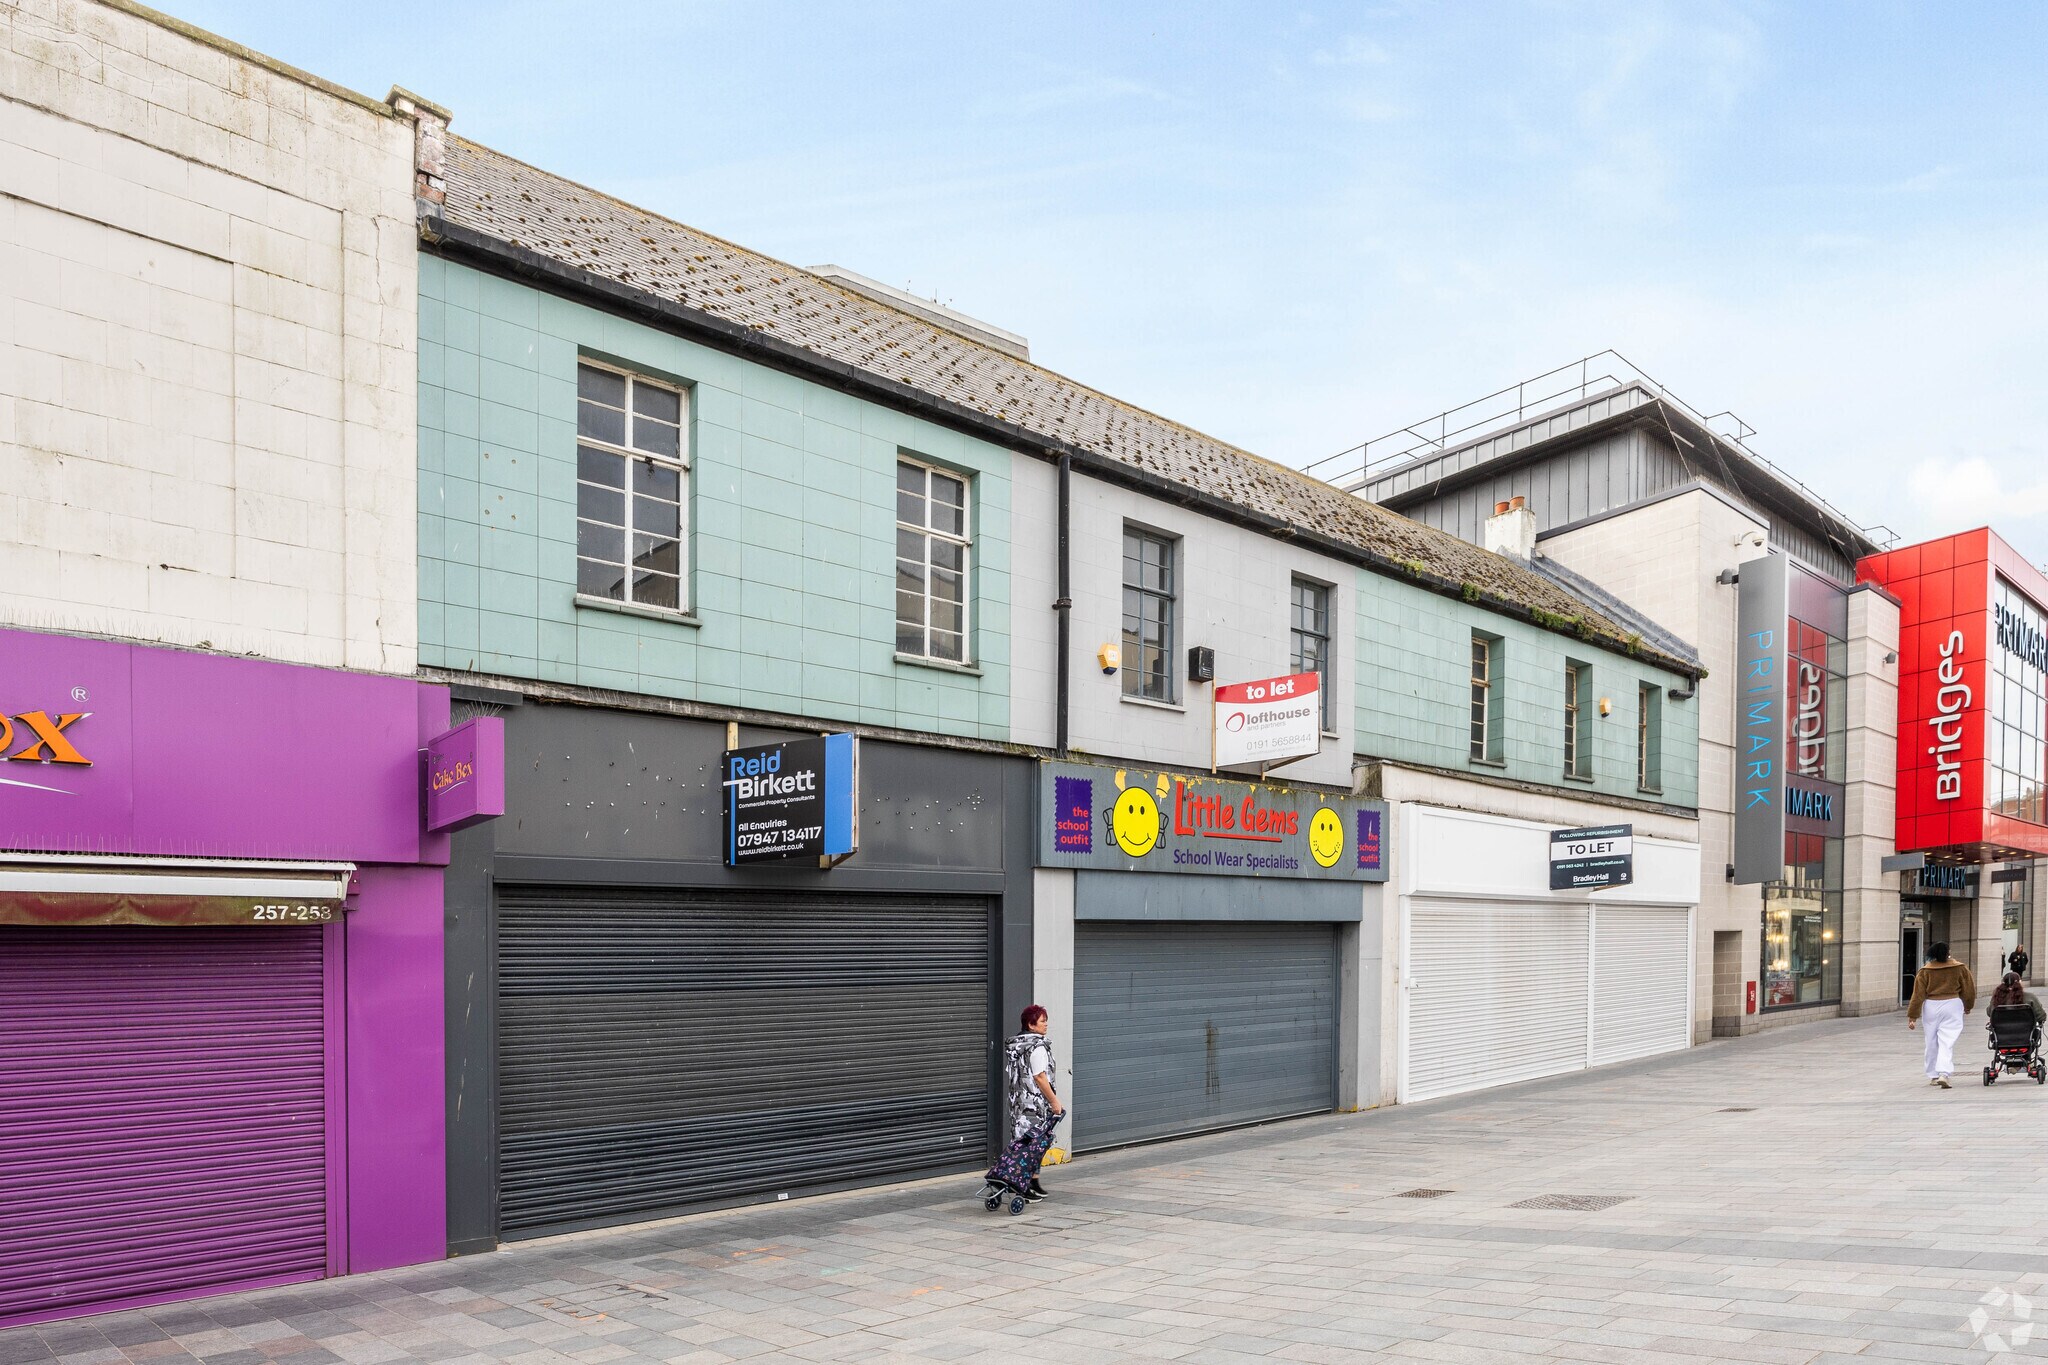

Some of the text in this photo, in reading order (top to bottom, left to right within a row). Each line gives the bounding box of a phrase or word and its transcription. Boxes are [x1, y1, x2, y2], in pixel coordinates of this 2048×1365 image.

[1994, 602, 2048, 677] PRIMAR
[1246, 679, 1295, 700] to let
[1247, 708, 1310, 725] lofthouse
[1746, 630, 1774, 810] PRIMARK
[1928, 630, 1972, 801] Bridges
[1261, 721, 1286, 731] partners
[1246, 739, 1268, 751] 0191
[1272, 733, 1311, 747] 5658844
[731, 750, 781, 777] Reid
[433, 761, 473, 790] Cake Box
[723, 770, 816, 799] Birkett
[738, 795, 816, 809] Commercial Property Consultants
[1174, 781, 1299, 837] Little Gems
[1785, 786, 1833, 821] IMARK
[1072, 806, 1089, 818] the
[738, 819, 788, 832] All Enquiries
[1057, 820, 1089, 831] school
[737, 826, 822, 847] 07947 134117
[1060, 834, 1089, 846] outfit
[1368, 833, 1379, 842] the
[1559, 831, 1586, 839] FOLLOWING
[1359, 843, 1379, 852] school
[1567, 841, 1614, 855] TO LET
[1173, 848, 1299, 871] School Wear Specialists
[1360, 854, 1379, 863] outfit
[1572, 874, 1597, 883] Bradley
[1597, 872, 1609, 881] Hall
[1923, 864, 1967, 889] PRIMARK
[253, 904, 332, 920] 257-258
